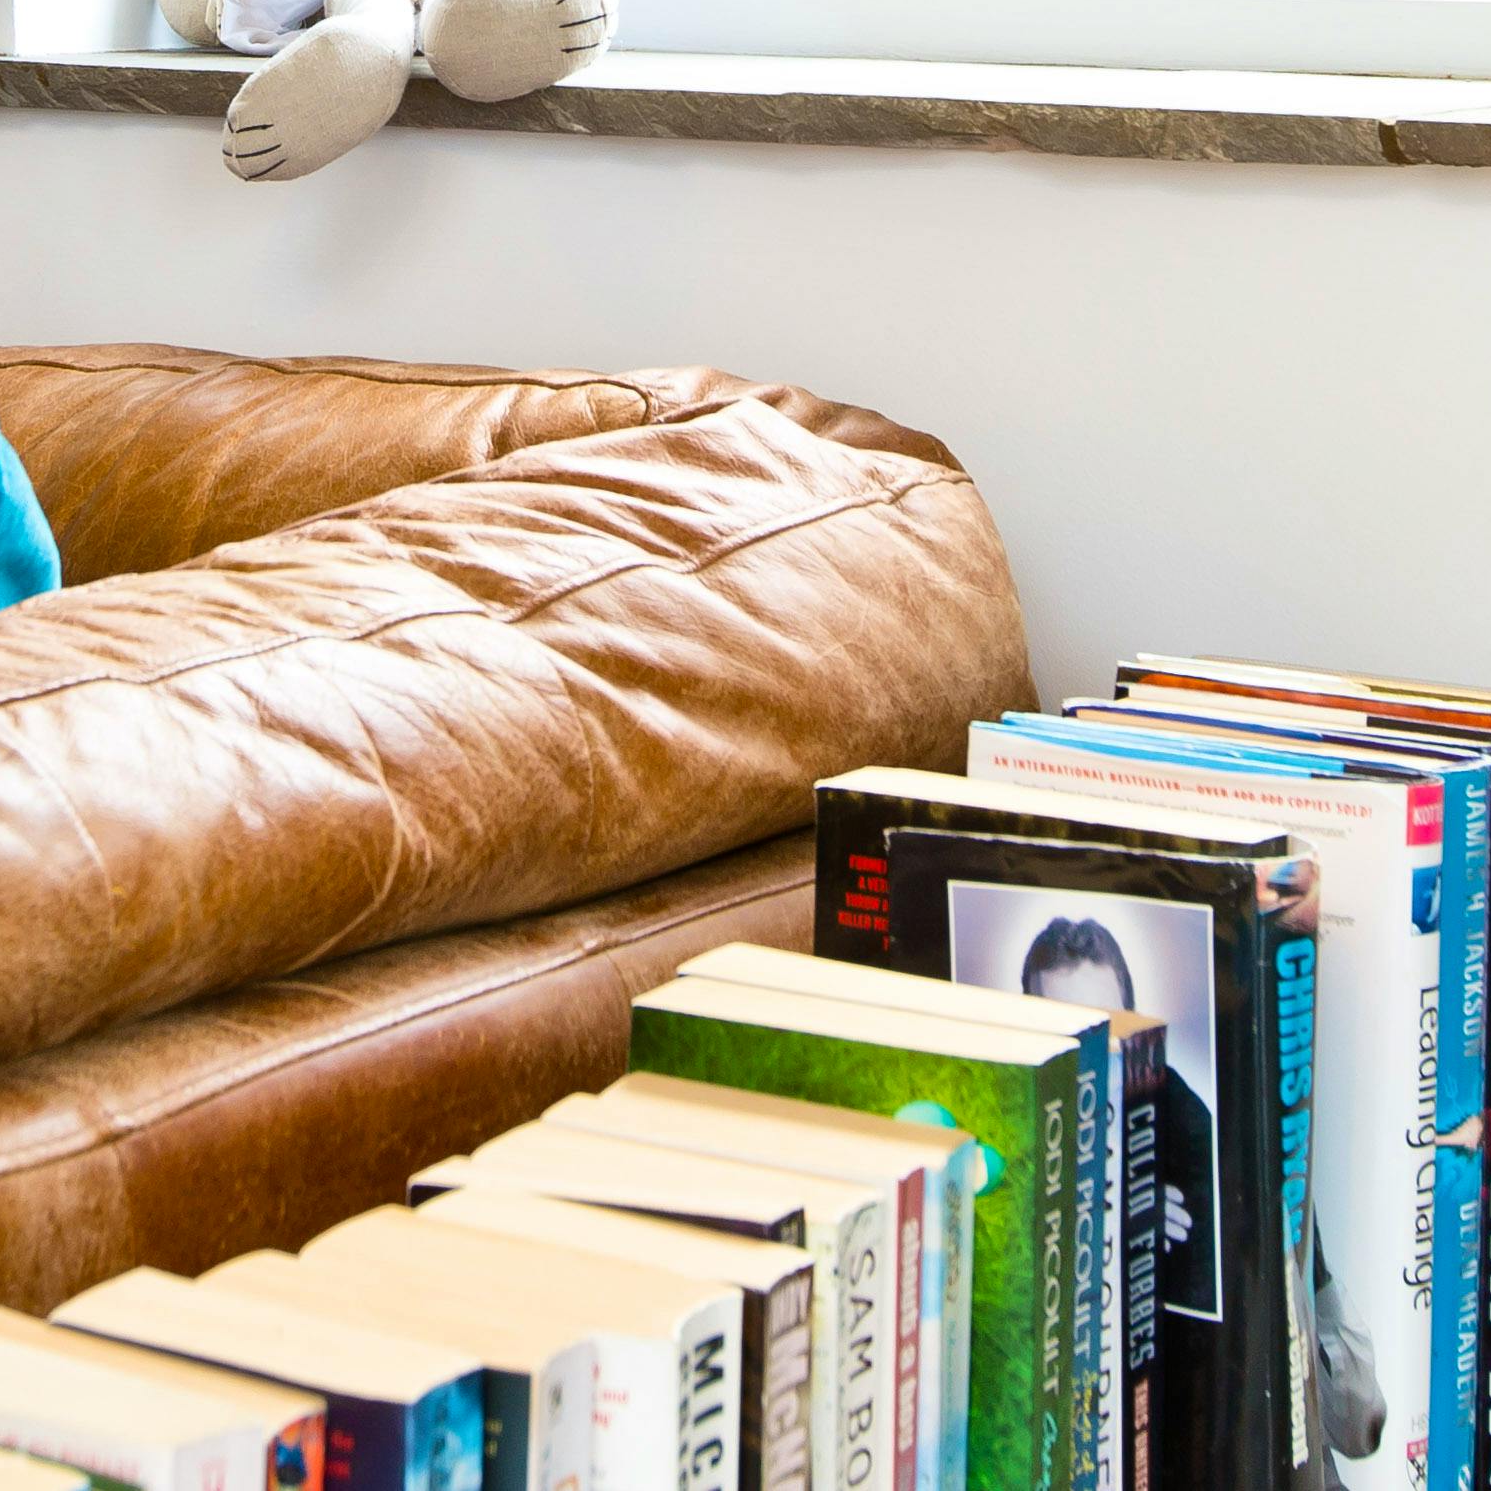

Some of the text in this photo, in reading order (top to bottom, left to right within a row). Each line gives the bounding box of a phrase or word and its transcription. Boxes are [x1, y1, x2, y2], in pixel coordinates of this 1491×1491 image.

[994, 755, 1009, 769] AN
[1013, 758, 1106, 782] INTERNATIONAL
[1288, 795, 1334, 814] COPIES
[1276, 937, 1317, 1108] CHRIS
[1128, 1103, 1156, 1371] COLIN FORBES
[1403, 986, 1440, 1311] Leading Change
[848, 1248, 876, 1382] SAM
[1043, 1210, 1062, 1396] PICOULT
[1074, 1176, 1096, 1361] PICOULT
[691, 1333, 725, 1491] MIC
